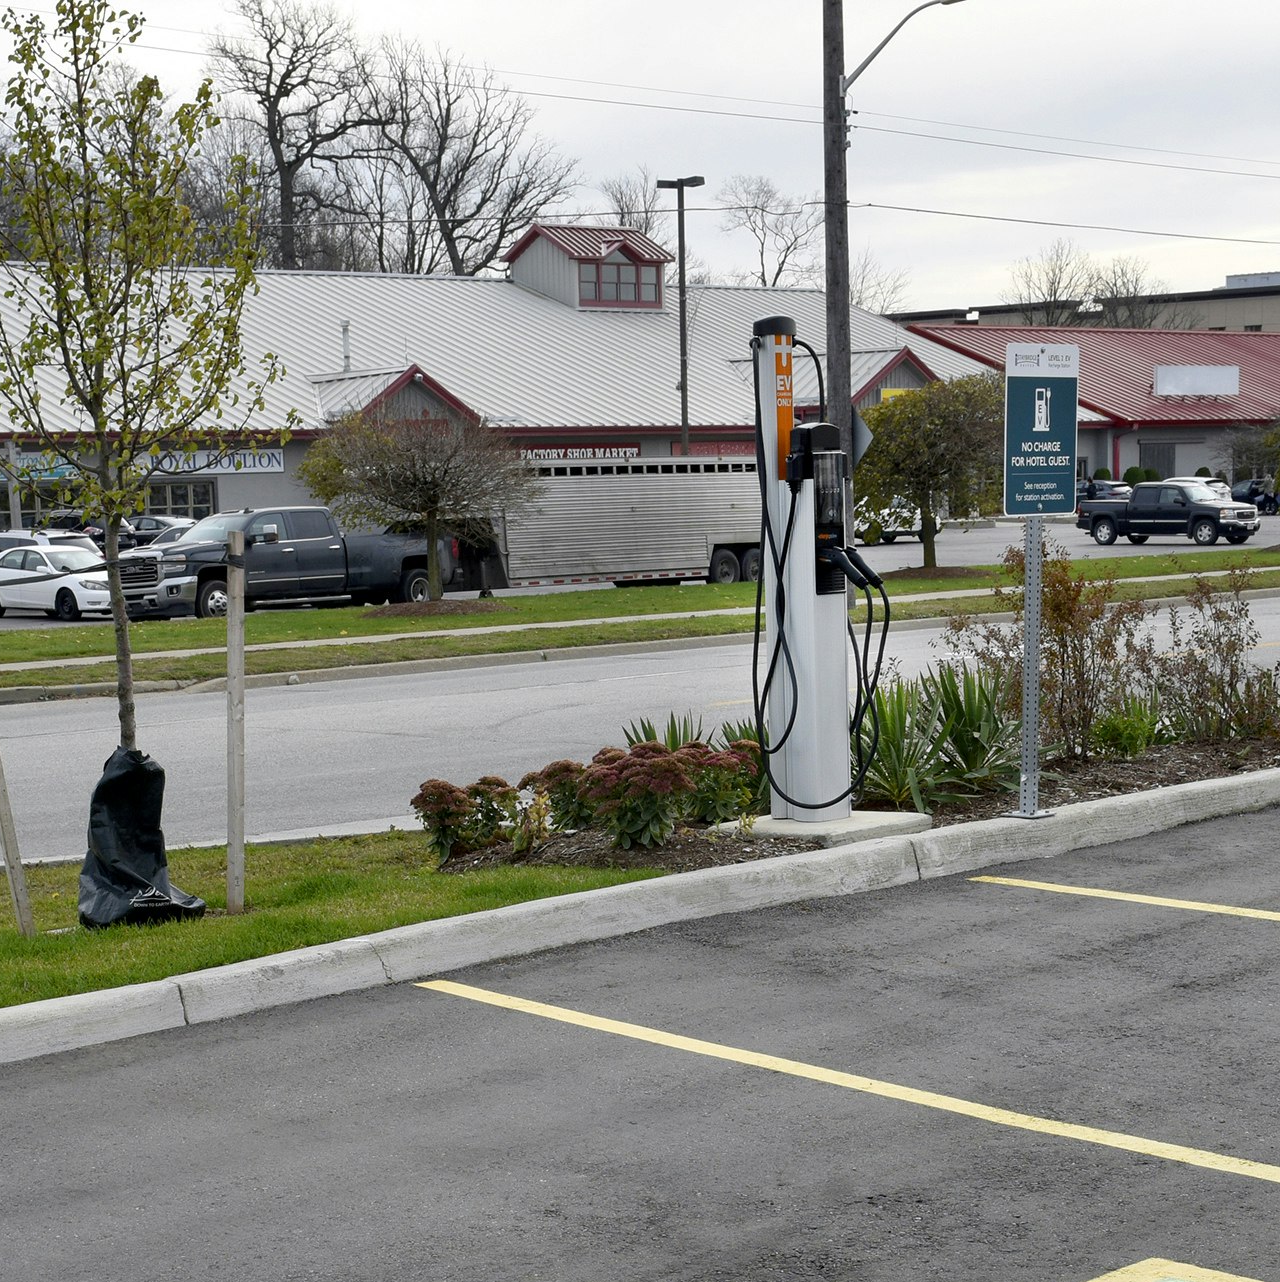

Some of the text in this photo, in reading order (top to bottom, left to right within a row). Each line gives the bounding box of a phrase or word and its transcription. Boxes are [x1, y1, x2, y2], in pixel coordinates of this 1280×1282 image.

[777, 375, 791, 390] EV
[1021, 441, 1061, 451] NO CHARGE
[520, 447, 639, 460] FACTORY SHOE MARKET
[207, 452, 282, 470] DOULTON
[1011, 455, 1070, 467] FOR HOTEL GUEST.
[1024, 481, 1057, 491] See reception
[1015, 493, 1024, 502] for
[1024, 493, 1040, 501] station
